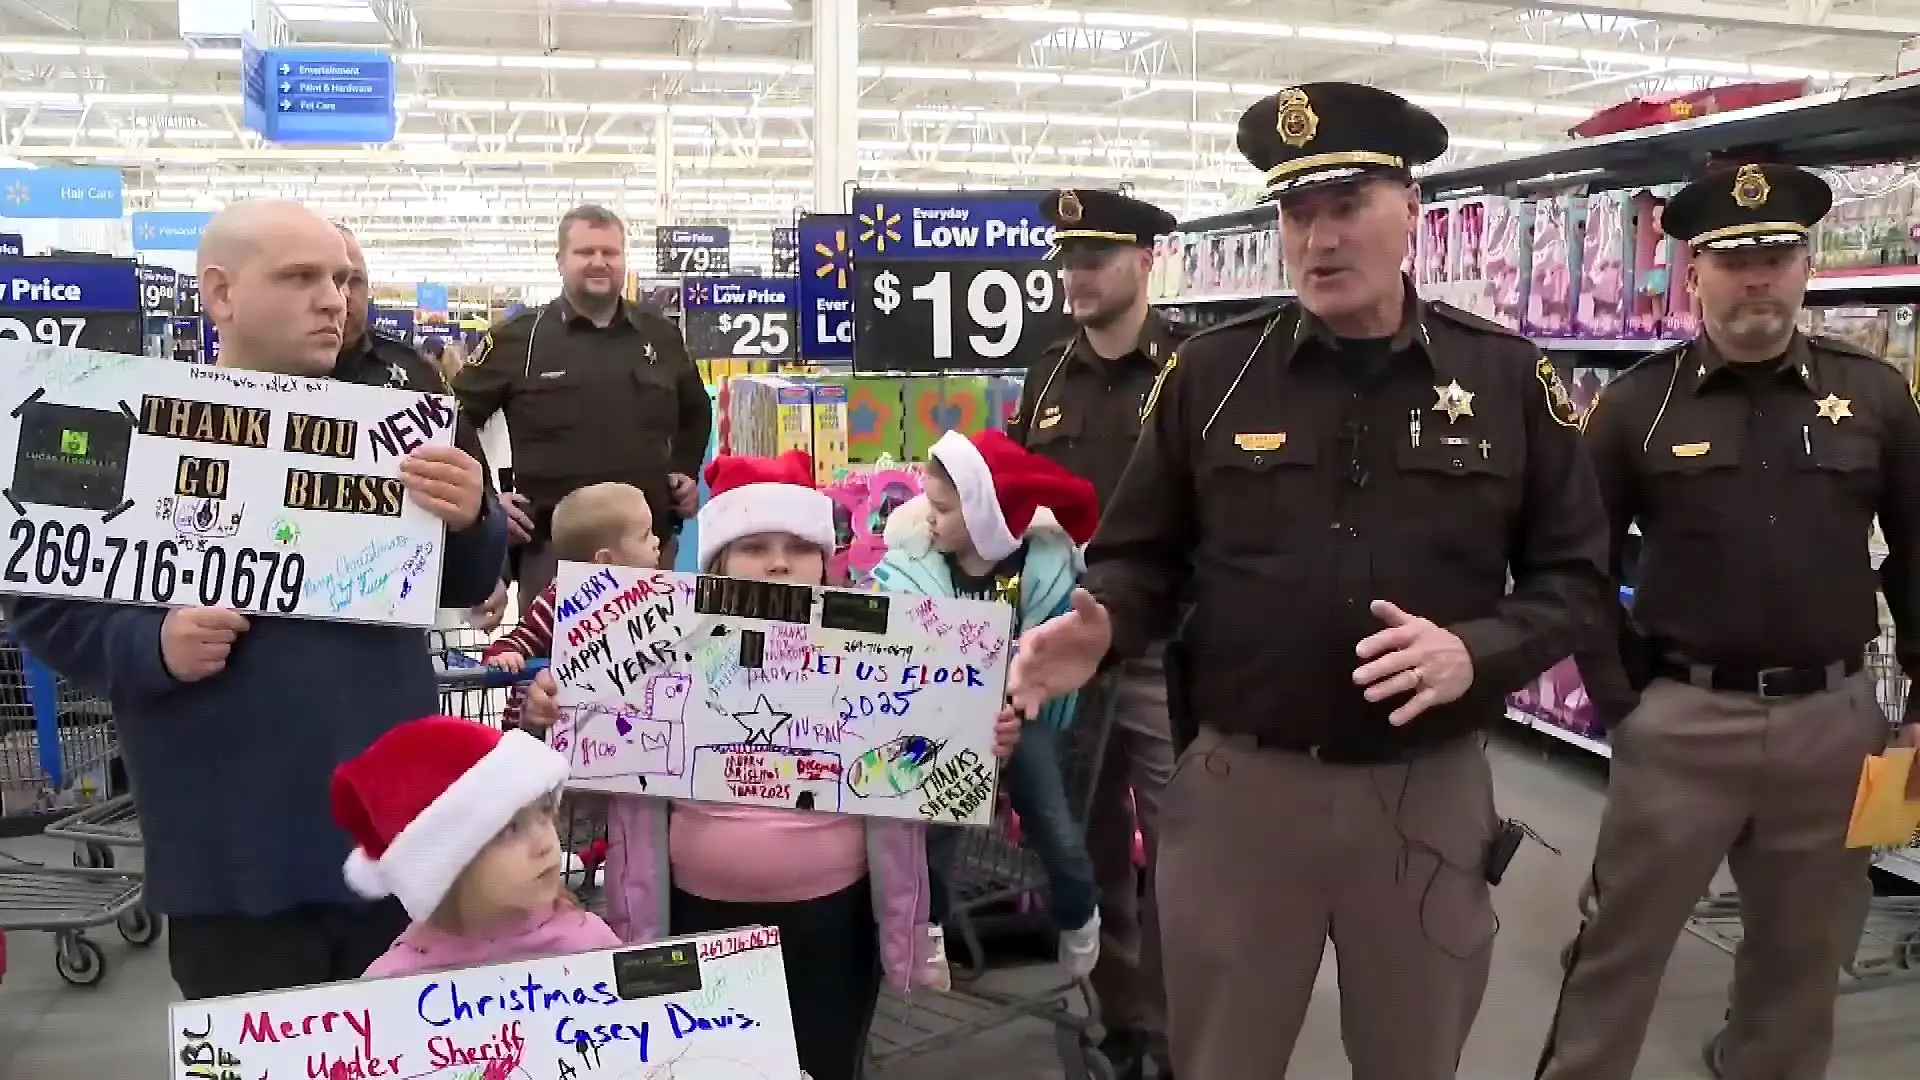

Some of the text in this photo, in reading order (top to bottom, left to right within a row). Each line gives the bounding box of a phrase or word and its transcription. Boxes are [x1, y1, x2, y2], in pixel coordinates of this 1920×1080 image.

[61, 187, 114, 200] Hair Care
[912, 208, 969, 221] Everyday
[159, 226, 197, 236] Personal
[913, 219, 979, 248] Low
[11, 277, 82, 301] Price
[714, 286, 786, 304] Low Price
[718, 311, 789, 355] $25
[143, 396, 355, 459] THANK YOU
[367, 393, 455, 464] NEWS
[177, 456, 404, 518] GO BLESS
[557, 567, 619, 622] MERRY
[556, 596, 675, 688] HAPPY NEW
[801, 650, 985, 687] LET US FLOOR
[839, 687, 922, 719] 2025
[239, 971, 620, 1061] Merry Christmas
[427, 1020, 524, 1069] Sheriff
[556, 1015, 649, 1063] Casey
